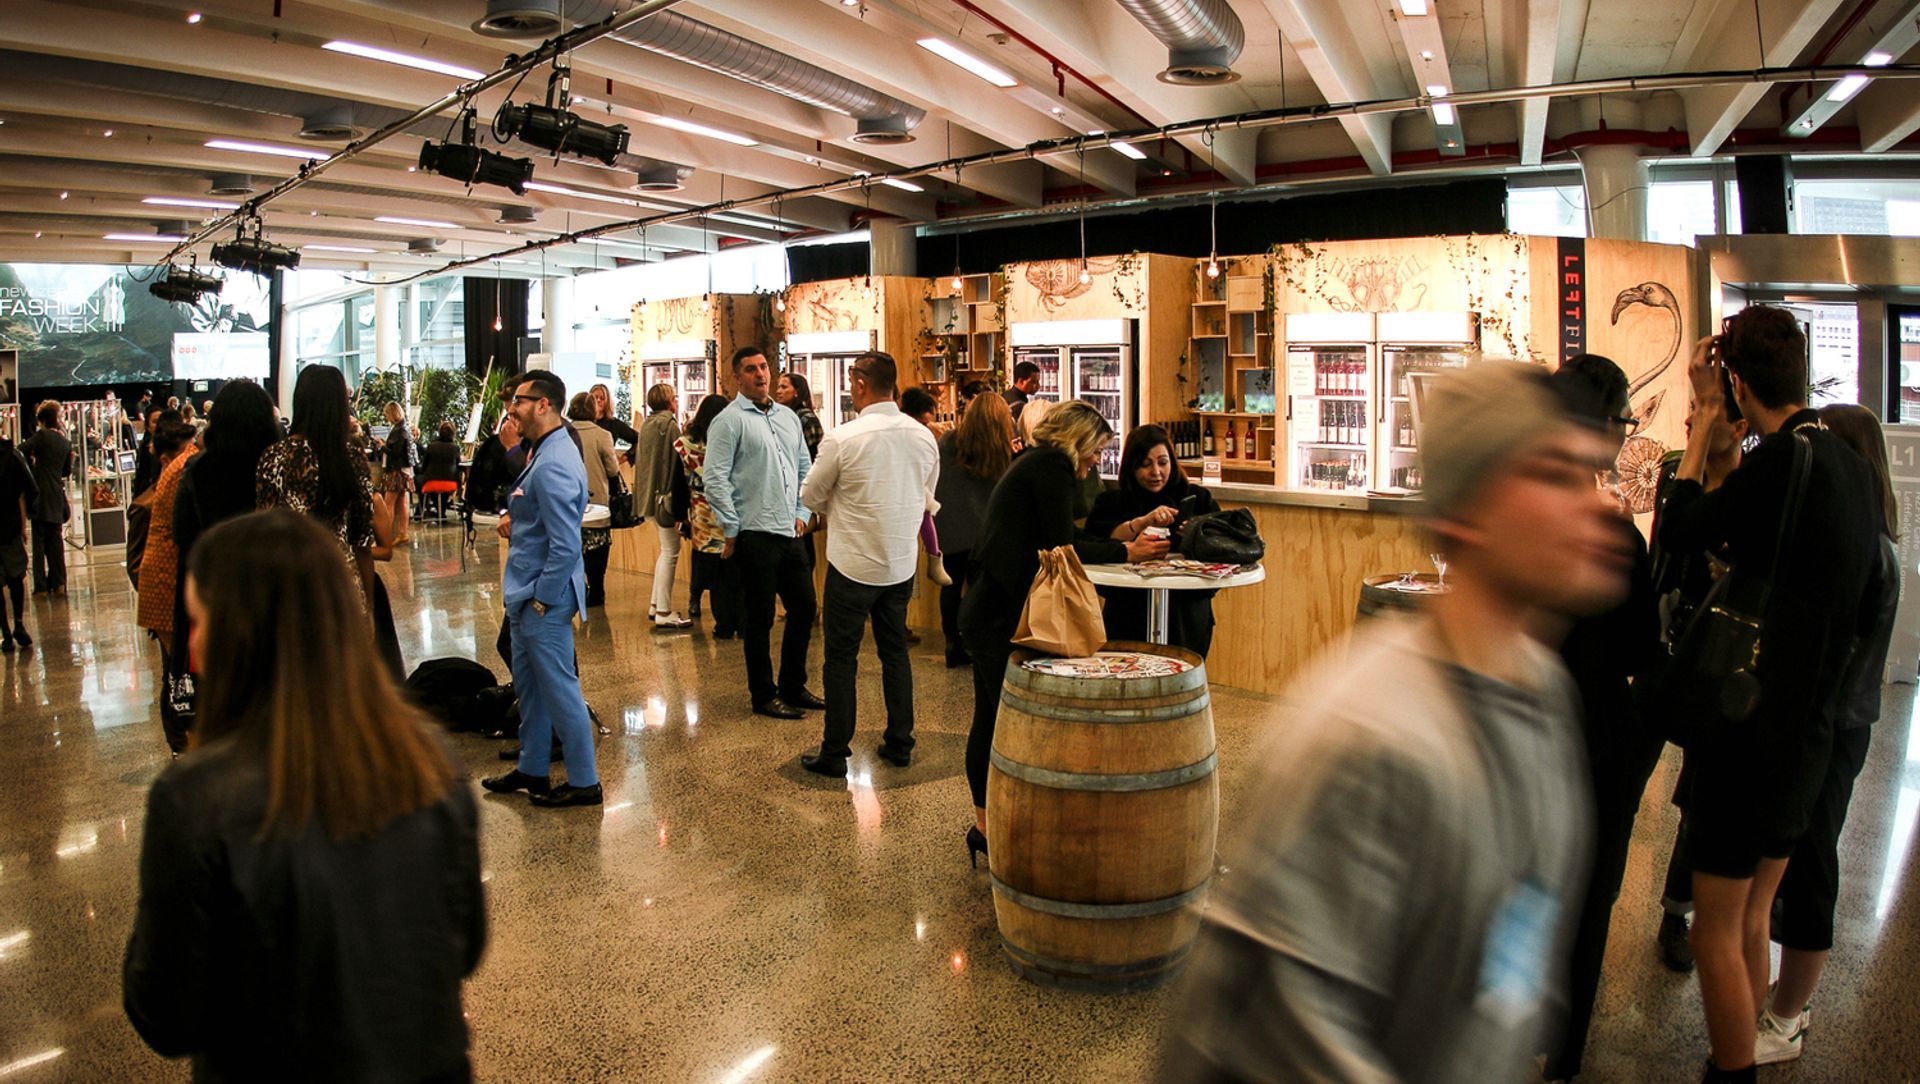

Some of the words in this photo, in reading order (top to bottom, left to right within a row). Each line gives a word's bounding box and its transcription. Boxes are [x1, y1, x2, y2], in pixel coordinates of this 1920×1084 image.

[0, 299, 100, 316] FASHION
[34, 316, 98, 334] WEEK
[1892, 445, 1914, 466] L1
[1903, 490, 1913, 533] Leftfield
[1901, 535, 1911, 561] Wine
